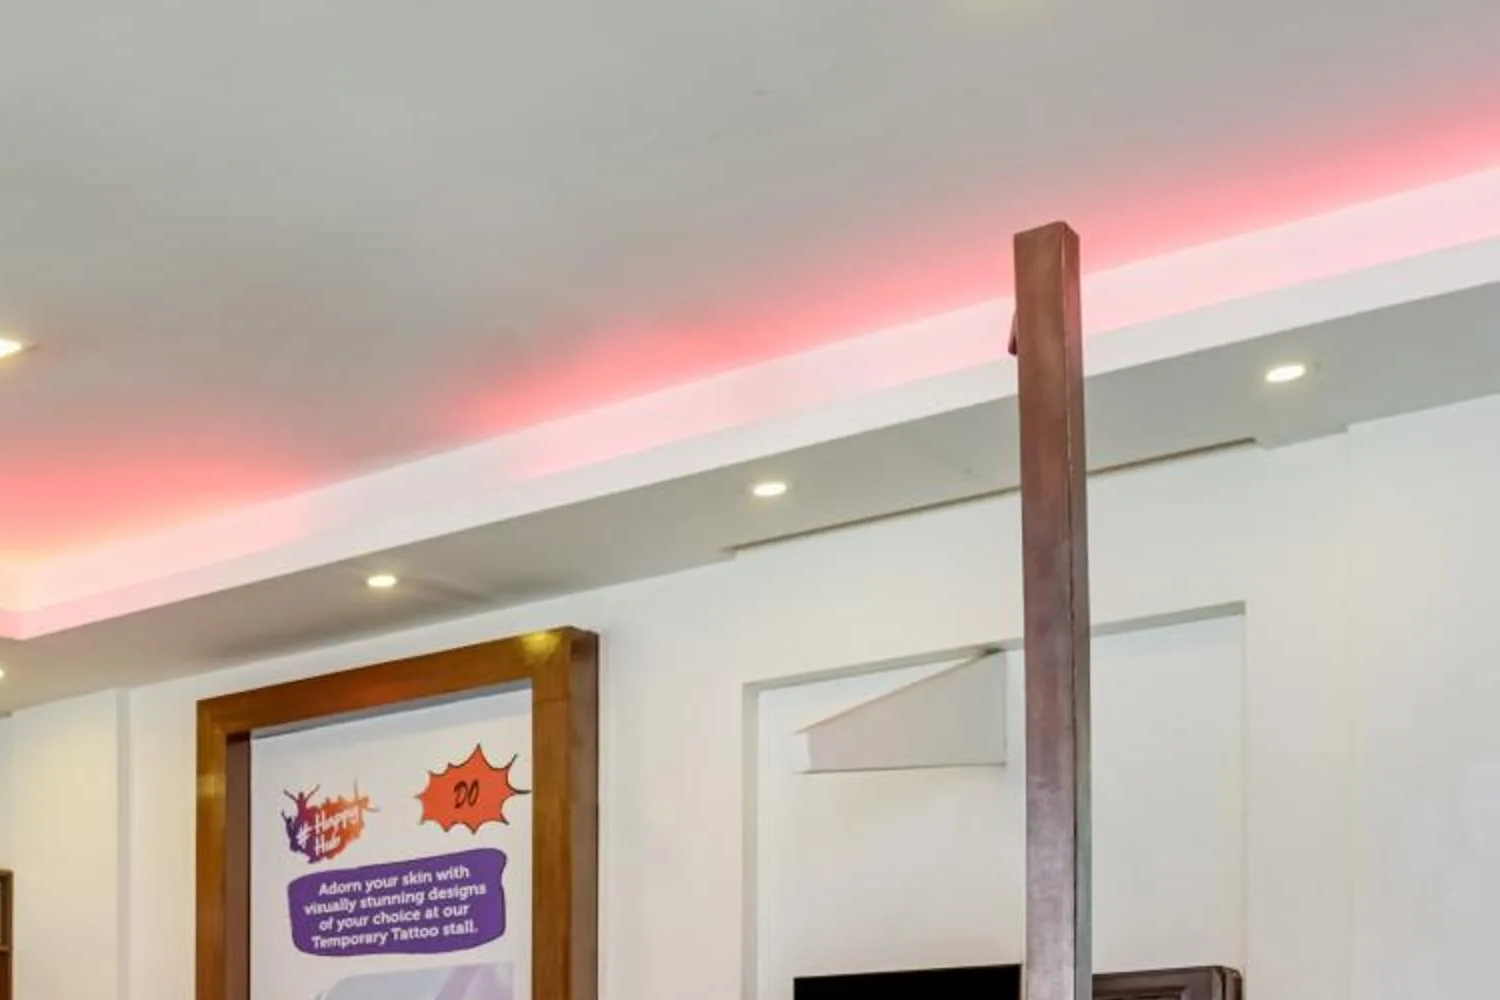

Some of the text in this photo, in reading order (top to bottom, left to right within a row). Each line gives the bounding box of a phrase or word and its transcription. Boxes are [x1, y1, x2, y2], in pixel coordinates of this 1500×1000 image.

[453, 778, 480, 809] DO
[318, 864, 470, 897] Adorn your skin with
[303, 882, 487, 916] visually stunning designs
[311, 918, 478, 950] Temporary Tattoo stall.
[319, 904, 469, 933] of your choice at our
